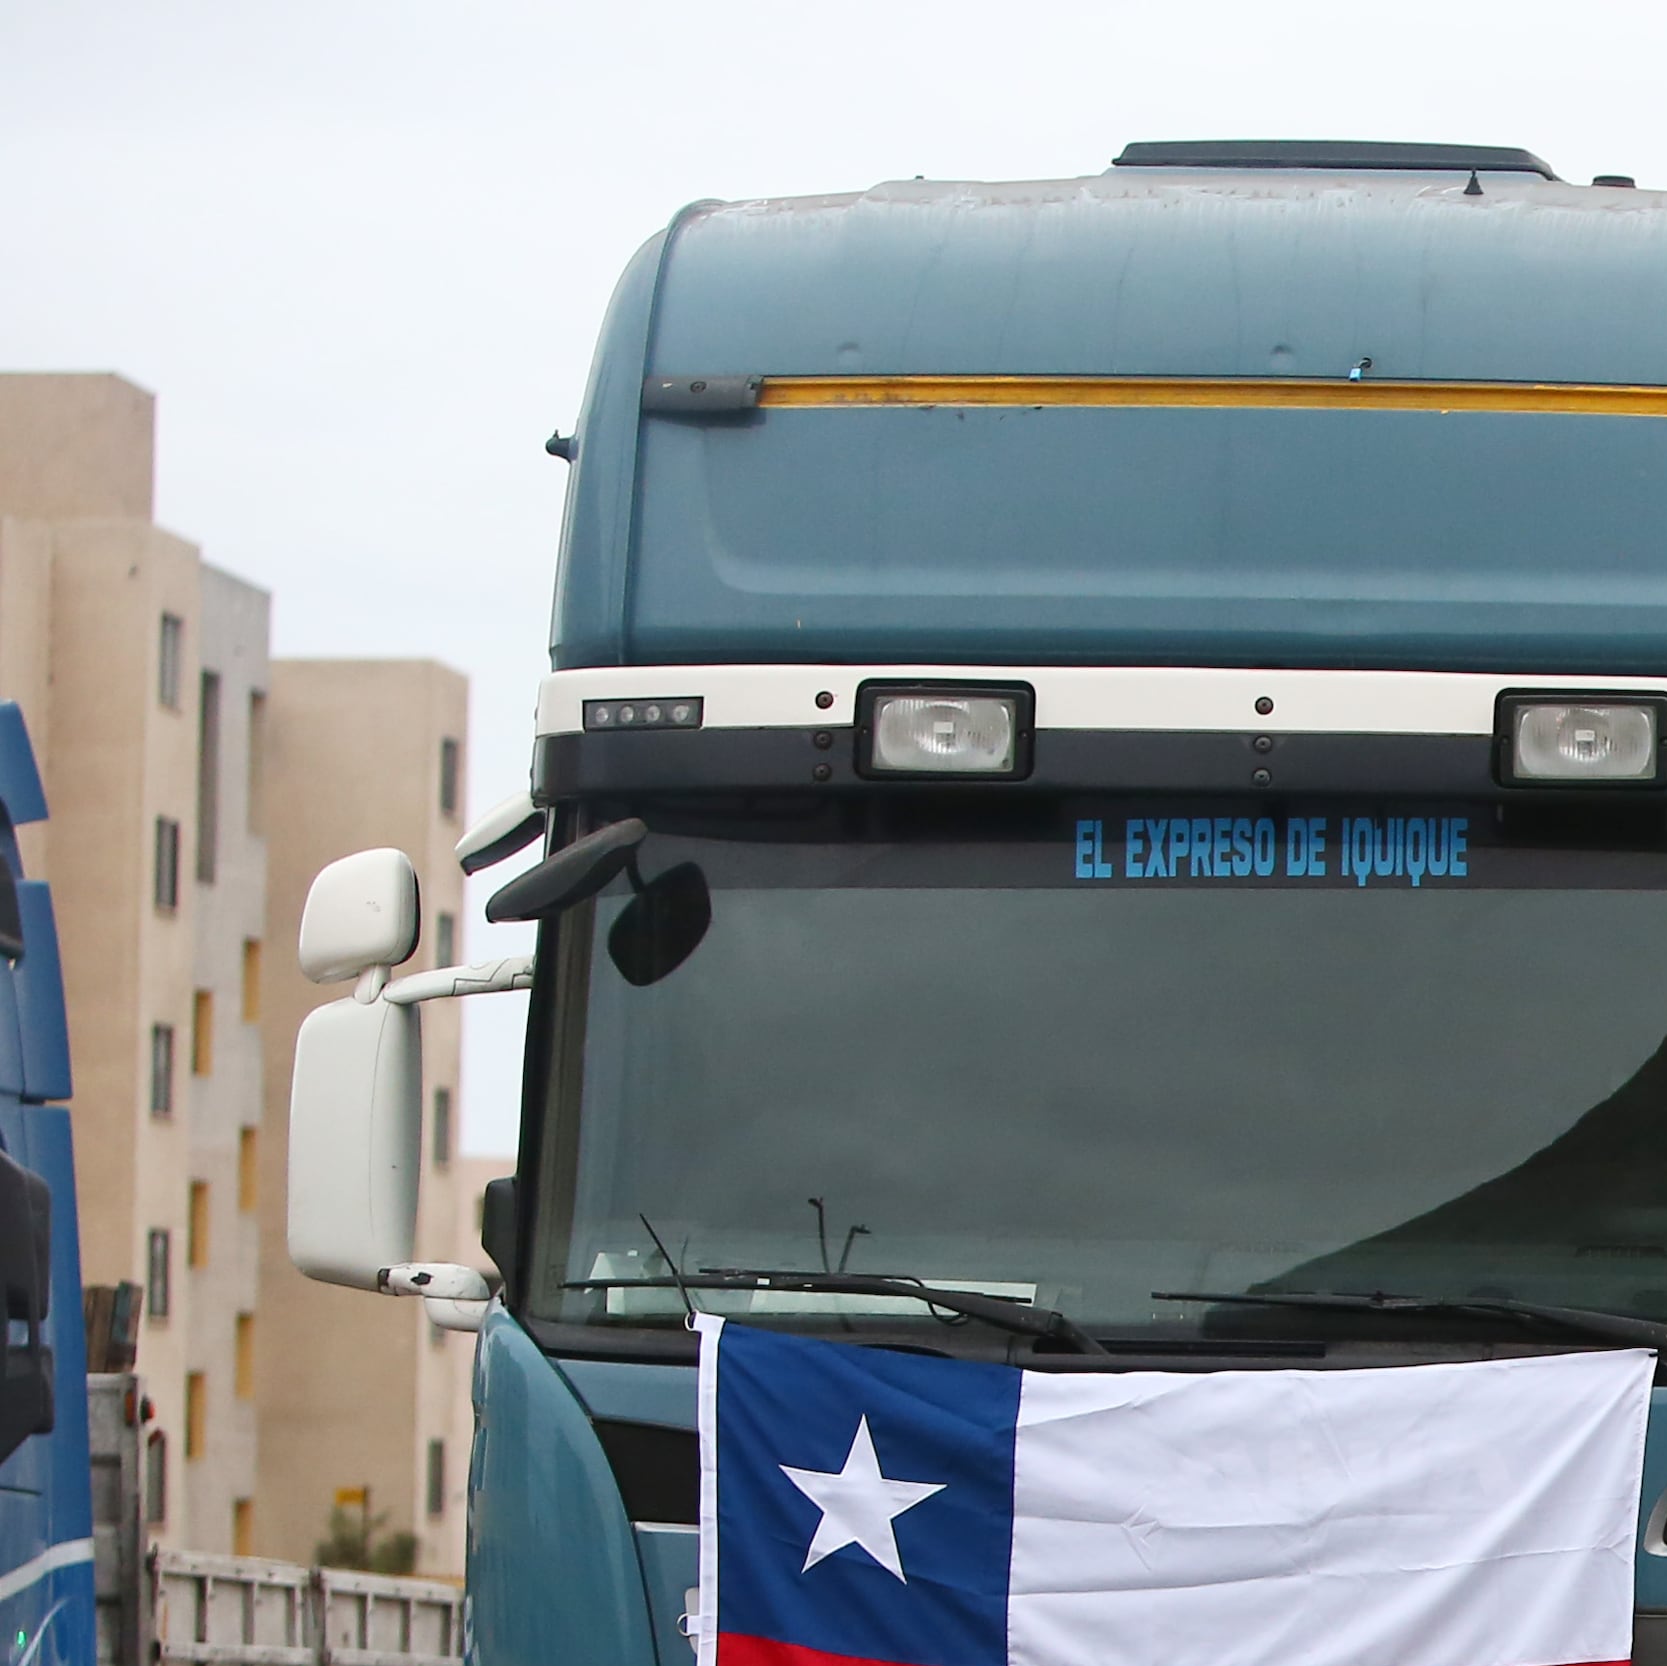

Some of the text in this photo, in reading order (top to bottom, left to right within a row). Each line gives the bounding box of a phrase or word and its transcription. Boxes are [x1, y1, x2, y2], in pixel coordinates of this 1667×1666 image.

[1076, 817, 1469, 887] EL EXPRESO DE IQUIQUE
